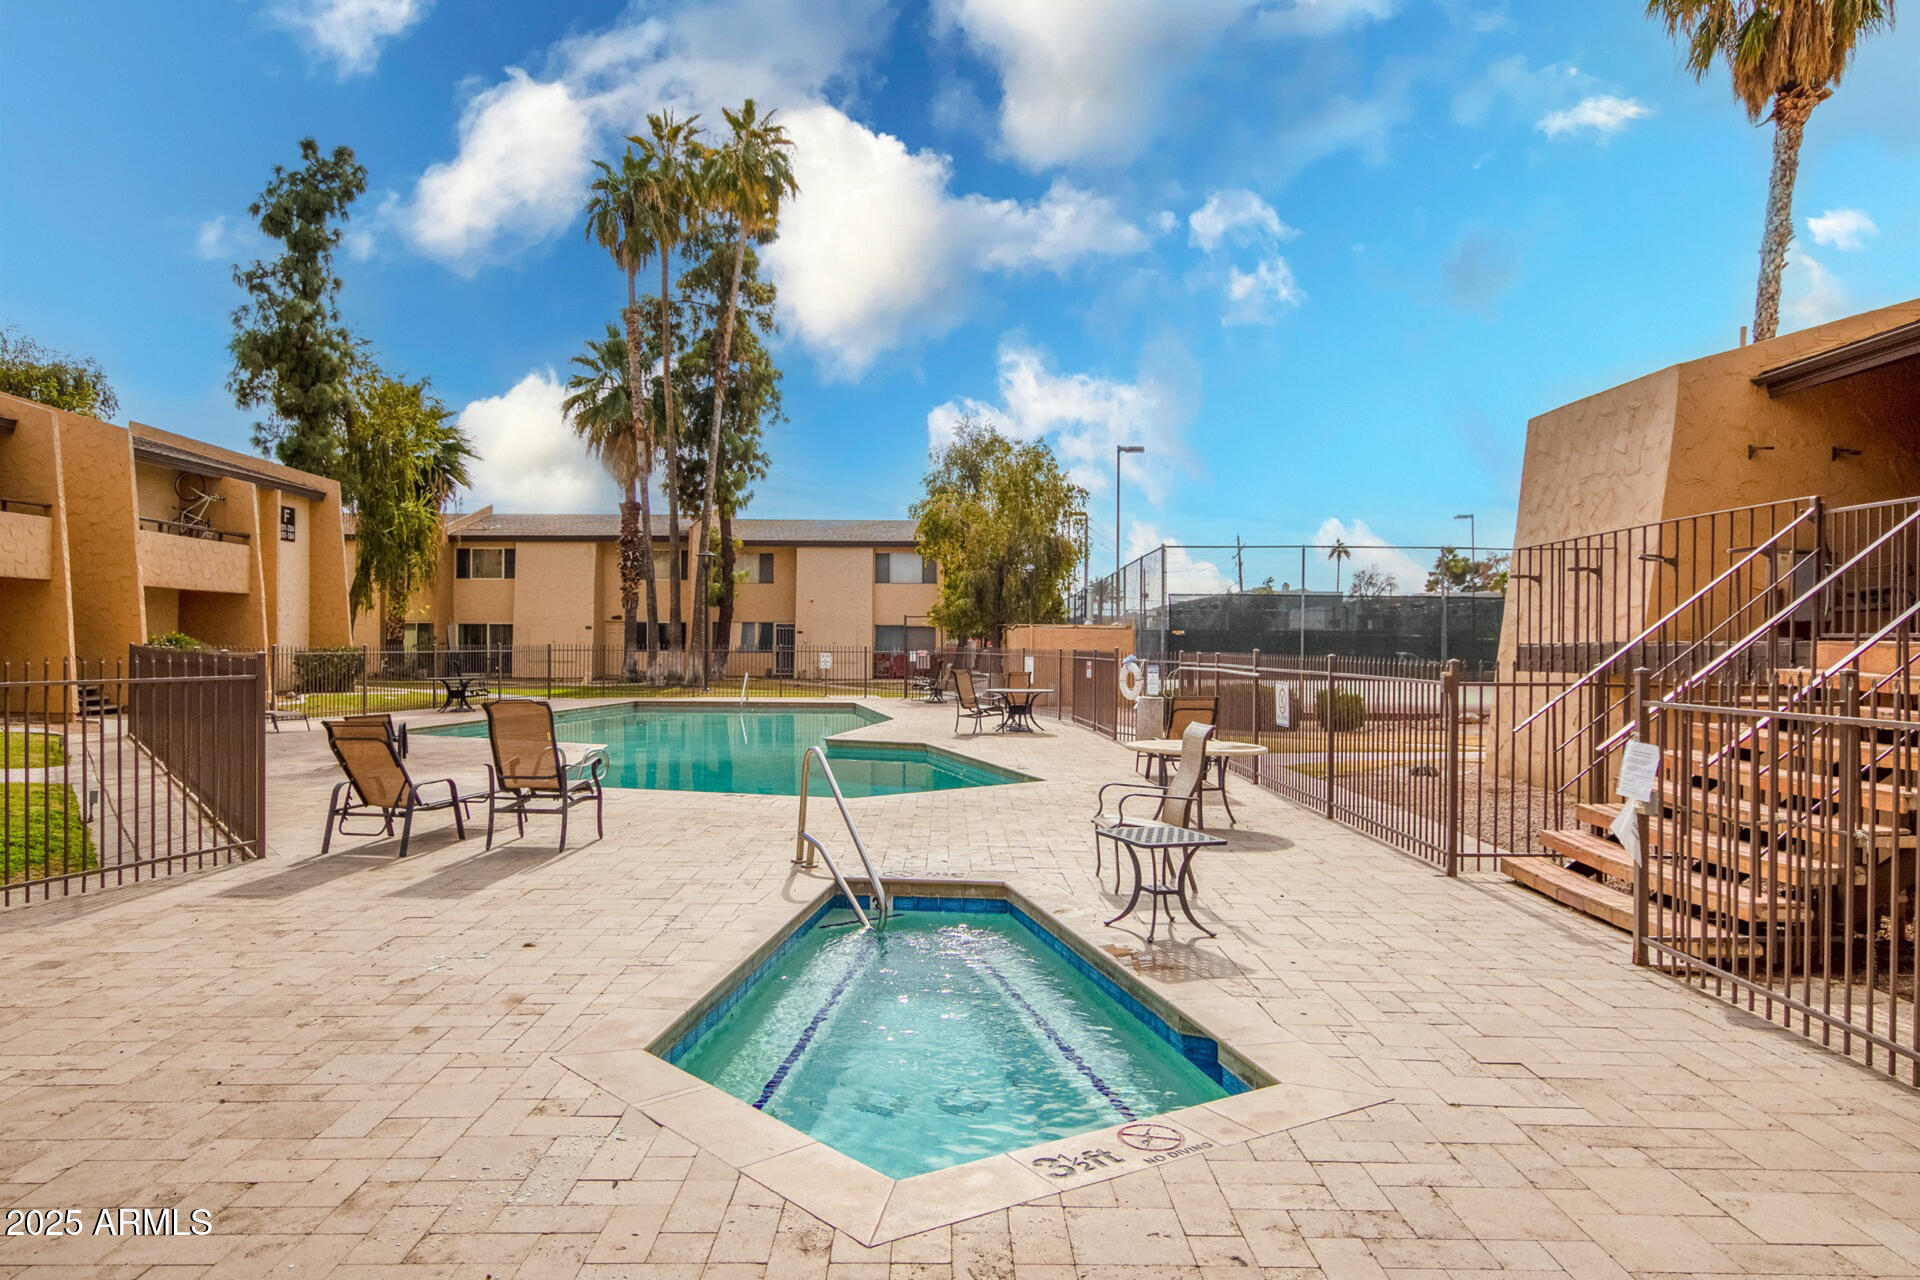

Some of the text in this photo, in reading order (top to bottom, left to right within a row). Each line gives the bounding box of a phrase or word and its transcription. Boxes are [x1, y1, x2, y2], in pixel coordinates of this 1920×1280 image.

[284, 509, 290, 522] F
[1143, 1142, 1214, 1165] NO DIVING
